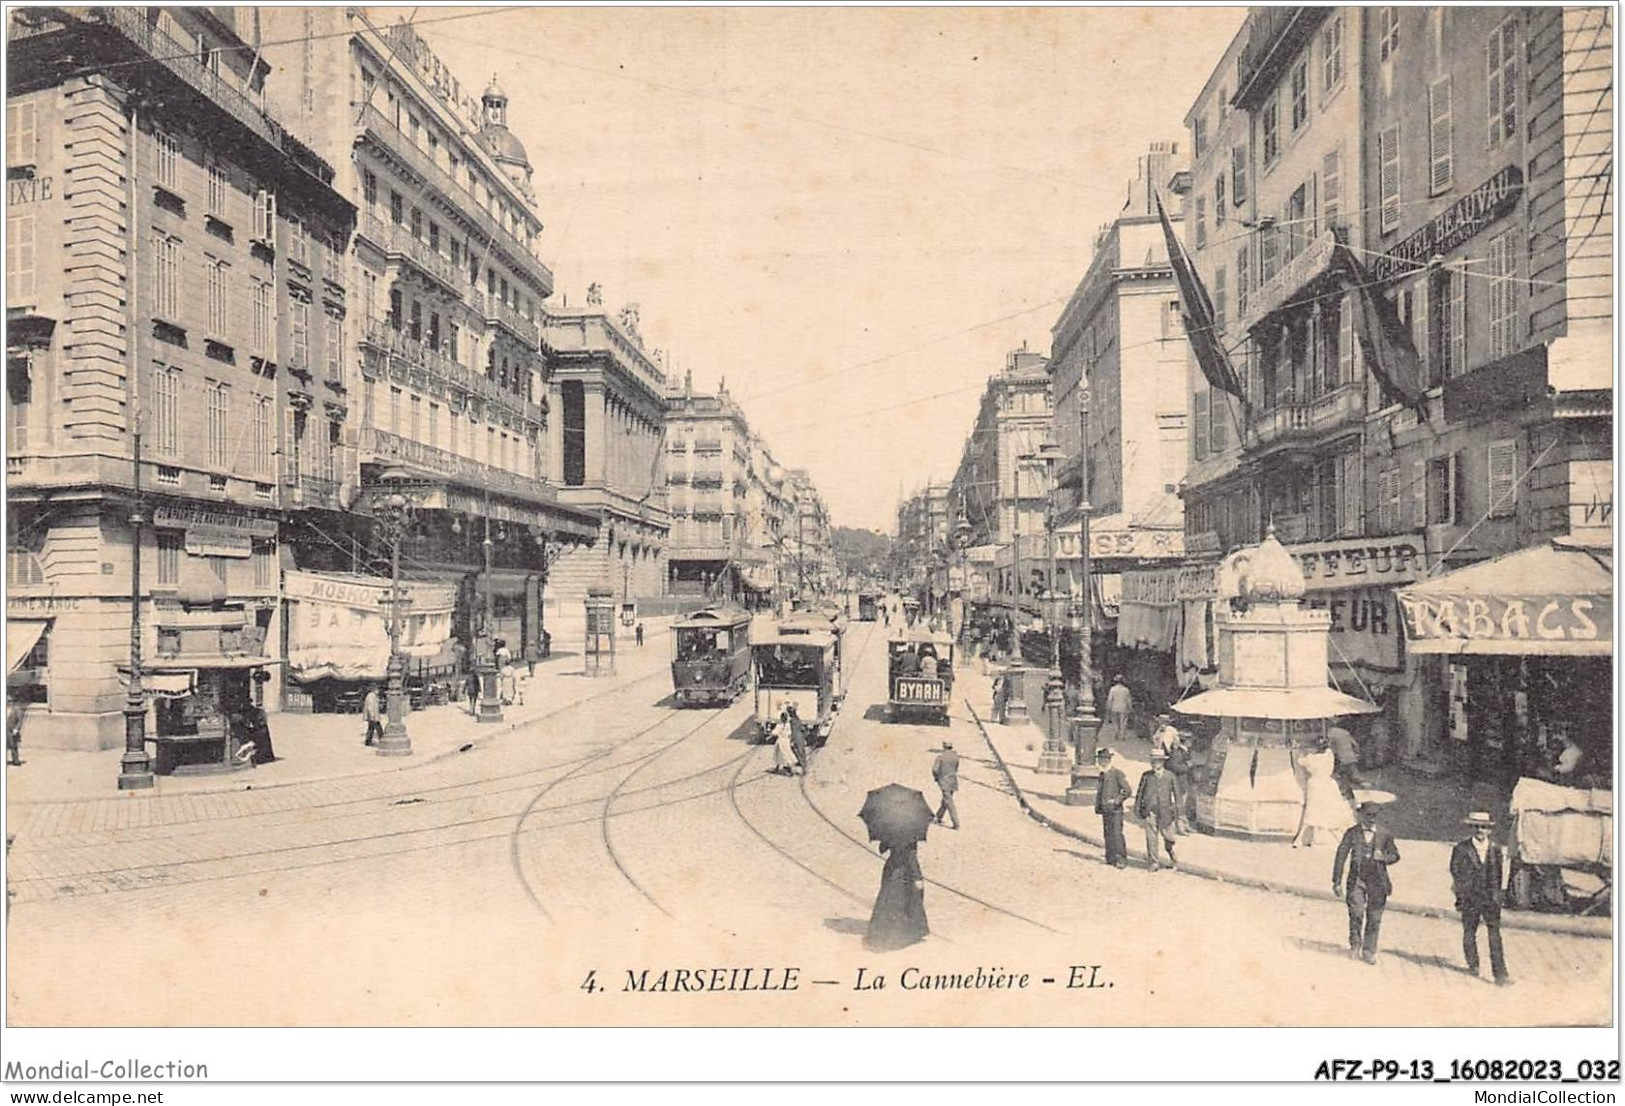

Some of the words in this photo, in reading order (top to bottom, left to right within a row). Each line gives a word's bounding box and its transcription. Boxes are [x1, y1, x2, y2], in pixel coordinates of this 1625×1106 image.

[9, 176, 53, 206] IXTE
[1436, 169, 1510, 244] BEAUVAU
[1058, 533, 1135, 555] USE
[1404, 599, 1598, 640] TABACS
[900, 682, 941, 700] BYRRH
